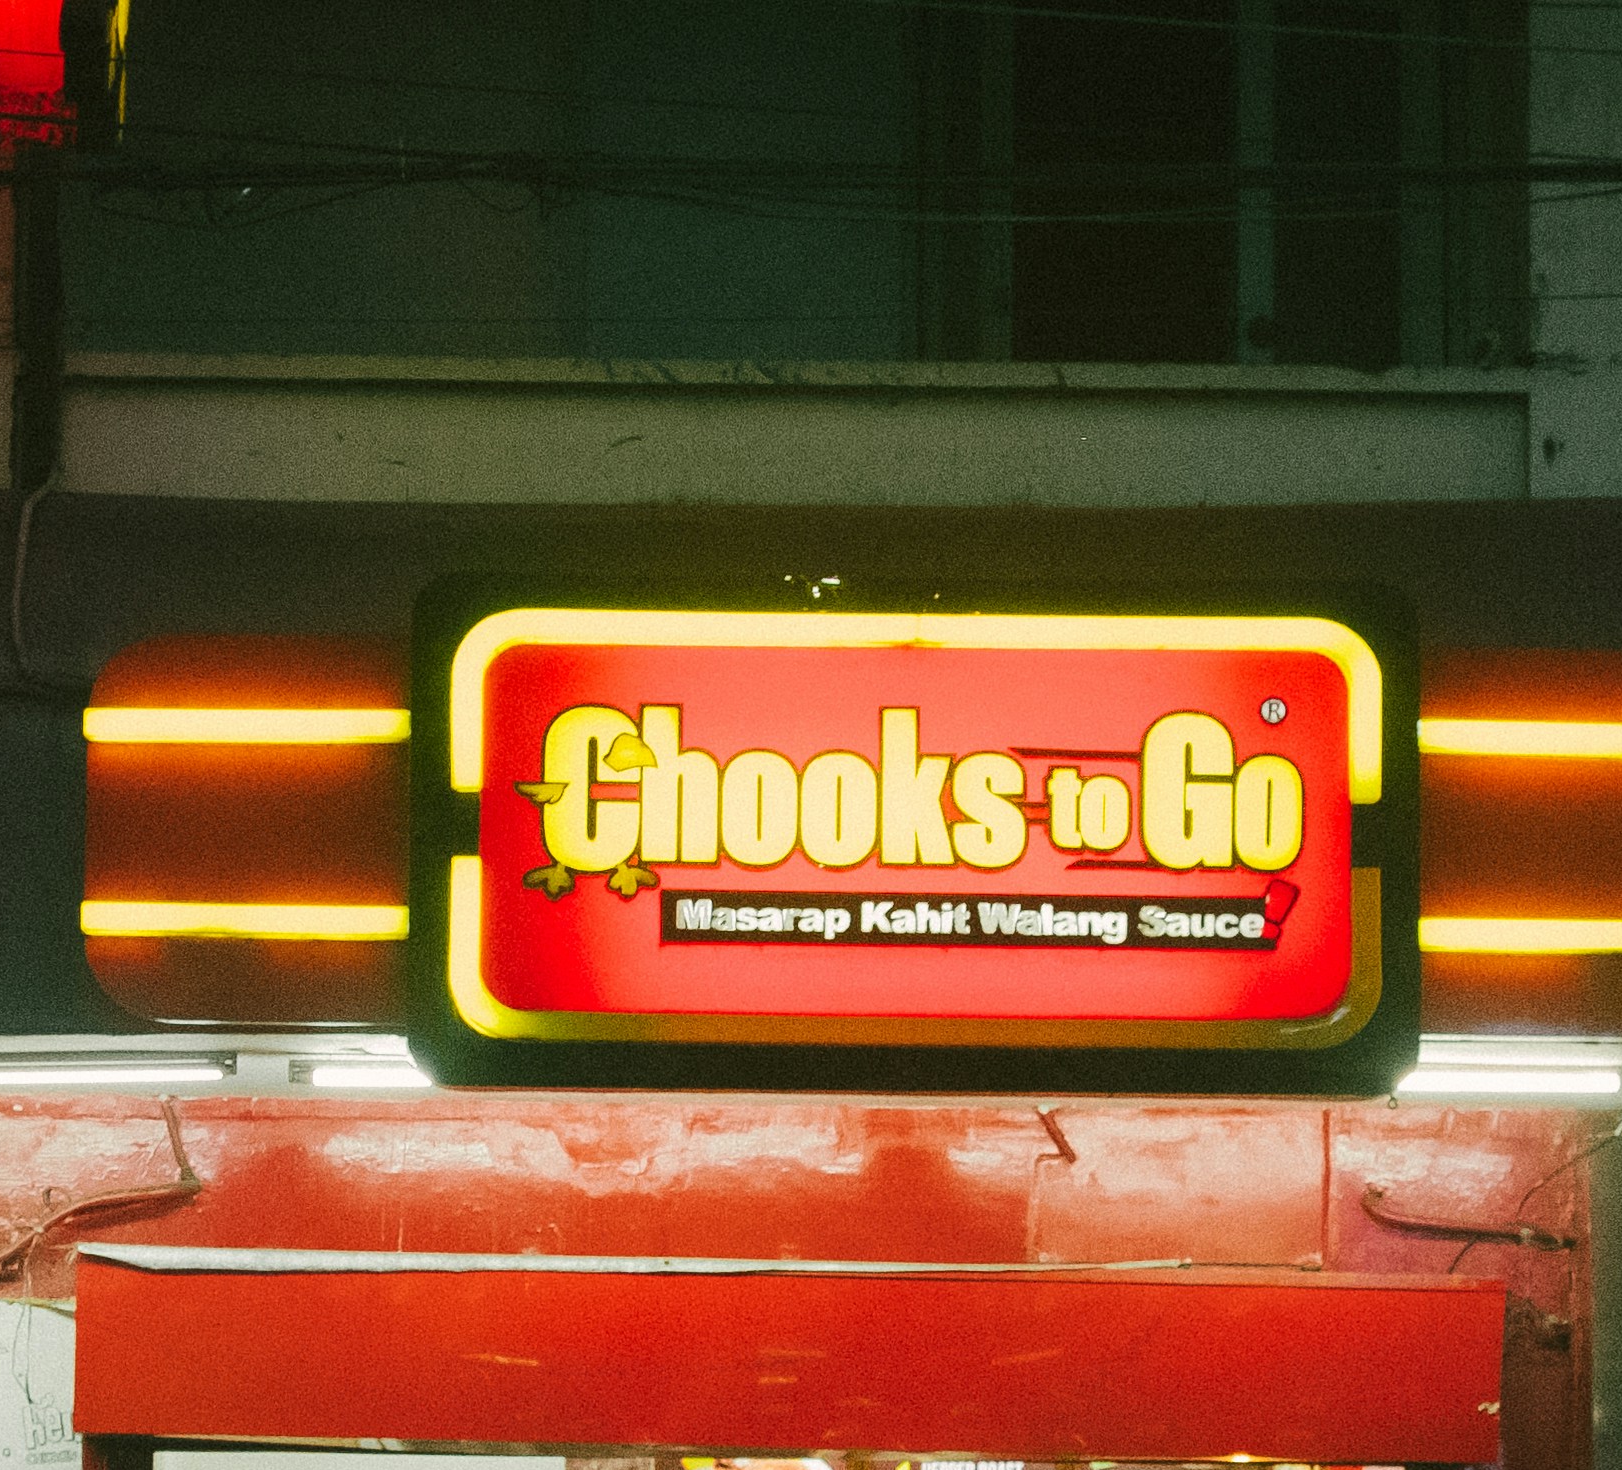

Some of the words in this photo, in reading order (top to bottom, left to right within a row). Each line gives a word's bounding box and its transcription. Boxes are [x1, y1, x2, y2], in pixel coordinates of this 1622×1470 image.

[540, 703, 1026, 872] Chooks
[1046, 766, 1130, 851] to
[1141, 711, 1303, 872] Go
[676, 898, 852, 940] Masarap
[860, 901, 972, 935] Kahit
[977, 902, 1127, 944] Walang
